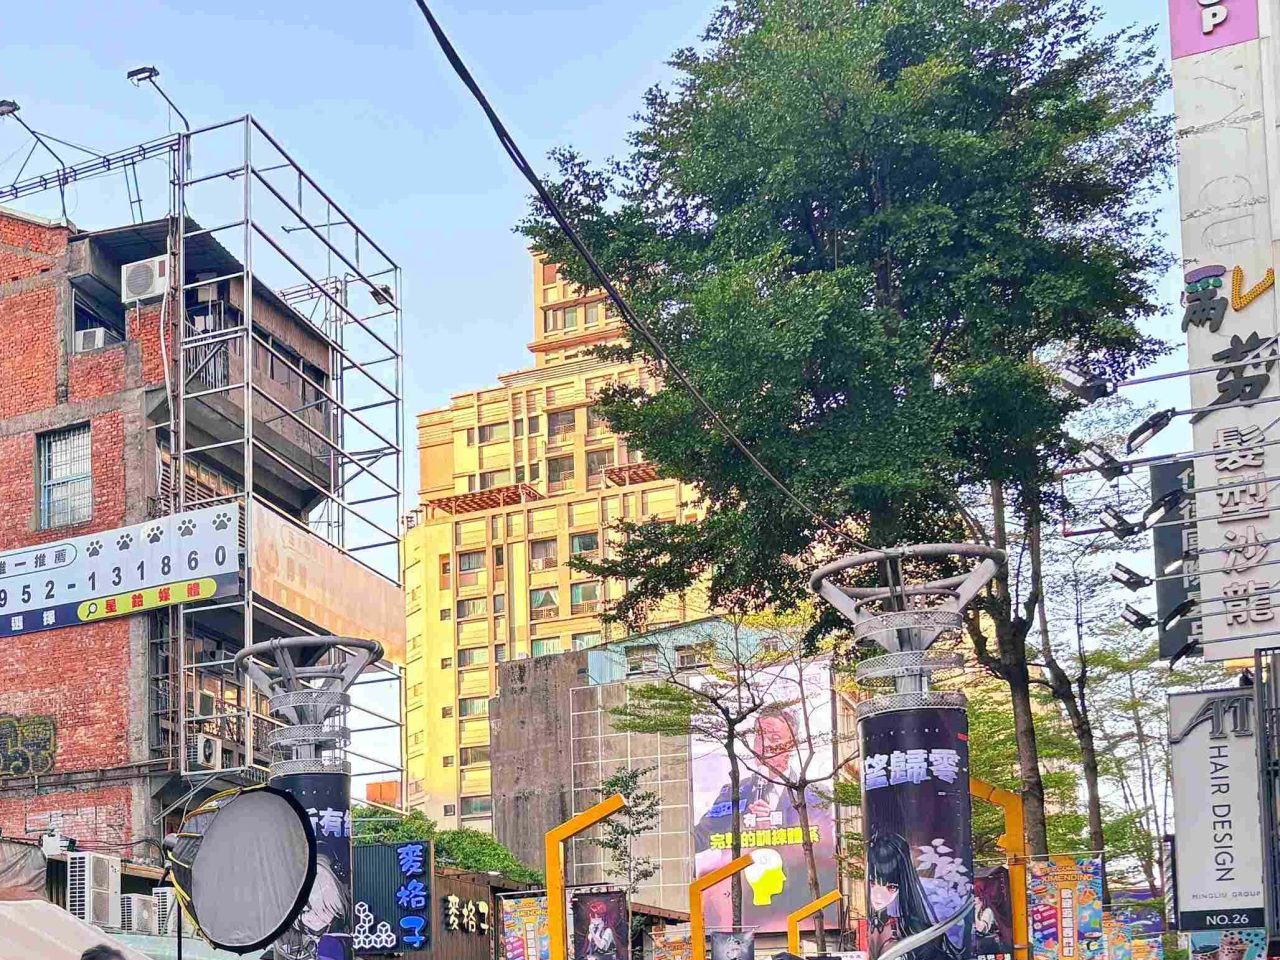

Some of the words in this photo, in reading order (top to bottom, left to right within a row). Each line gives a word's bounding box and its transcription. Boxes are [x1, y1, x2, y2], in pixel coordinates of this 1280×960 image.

[1197, 0, 1228, 35] P
[1212, 424, 1275, 626] 髮型沙龍
[1209, 745, 1230, 795] HAIR
[1212, 804, 1235, 882] DESIGN
[1231, 890, 1261, 899] GROUP
[1205, 913, 1250, 926] NO.26
